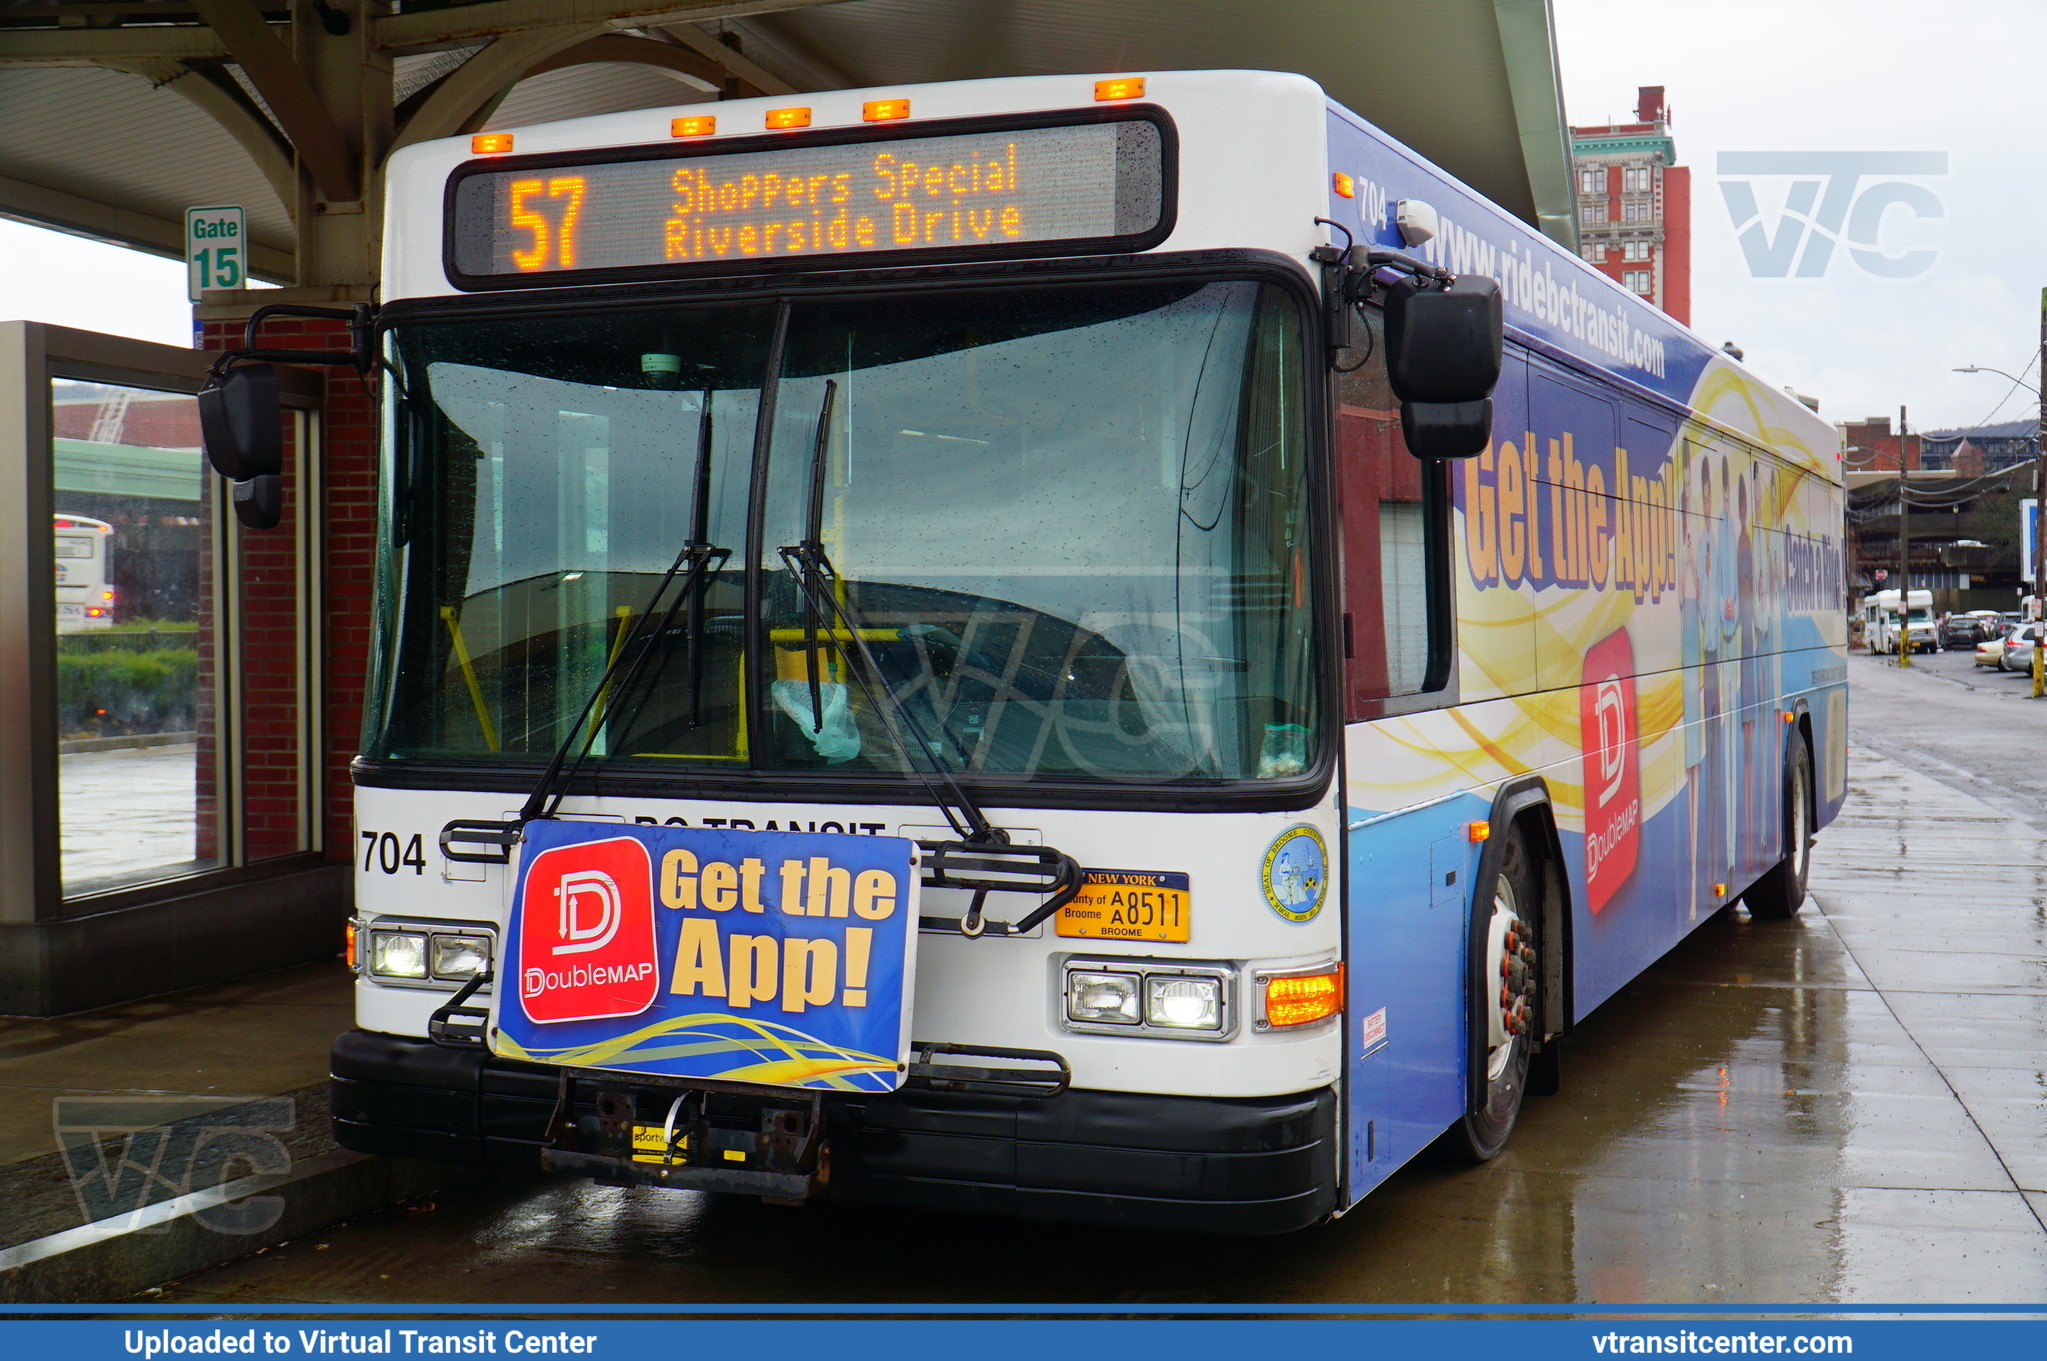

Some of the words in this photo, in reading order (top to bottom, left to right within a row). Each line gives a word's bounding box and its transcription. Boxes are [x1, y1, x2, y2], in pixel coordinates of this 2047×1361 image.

[671, 166, 850, 217] Shoppers
[872, 143, 1016, 200] Special
[1359, 175, 1388, 231] 704
[194, 218, 239, 239] Gate
[510, 177, 586, 272] 57
[665, 206, 875, 261] Riverside
[893, 202, 1021, 246] Drive
[193, 247, 239, 288] 15
[1424, 214, 1666, 379] www.ridebctransit.com
[1464, 431, 1543, 589] Get
[1548, 431, 1610, 590] the
[1615, 446, 1677, 604] App!
[1785, 523, 1816, 613] Catch
[1816, 545, 1823, 611] a
[361, 830, 427, 876] 704
[1271, 830, 1298, 854] BROOME
[1587, 798, 1639, 885] DoubleMAP
[659, 848, 767, 914] Get
[779, 855, 897, 922] the
[1066, 894, 1094, 907] unty
[1096, 894, 1107, 905] of
[1088, 873, 1120, 885] NEW
[1121, 874, 1157, 887] YORK
[1064, 907, 1102, 920] Broome
[1101, 927, 1142, 937] BROOME
[523, 961, 654, 999] DoubleMAP
[669, 917, 874, 1014] App!
[634, 1131, 686, 1145] sports
